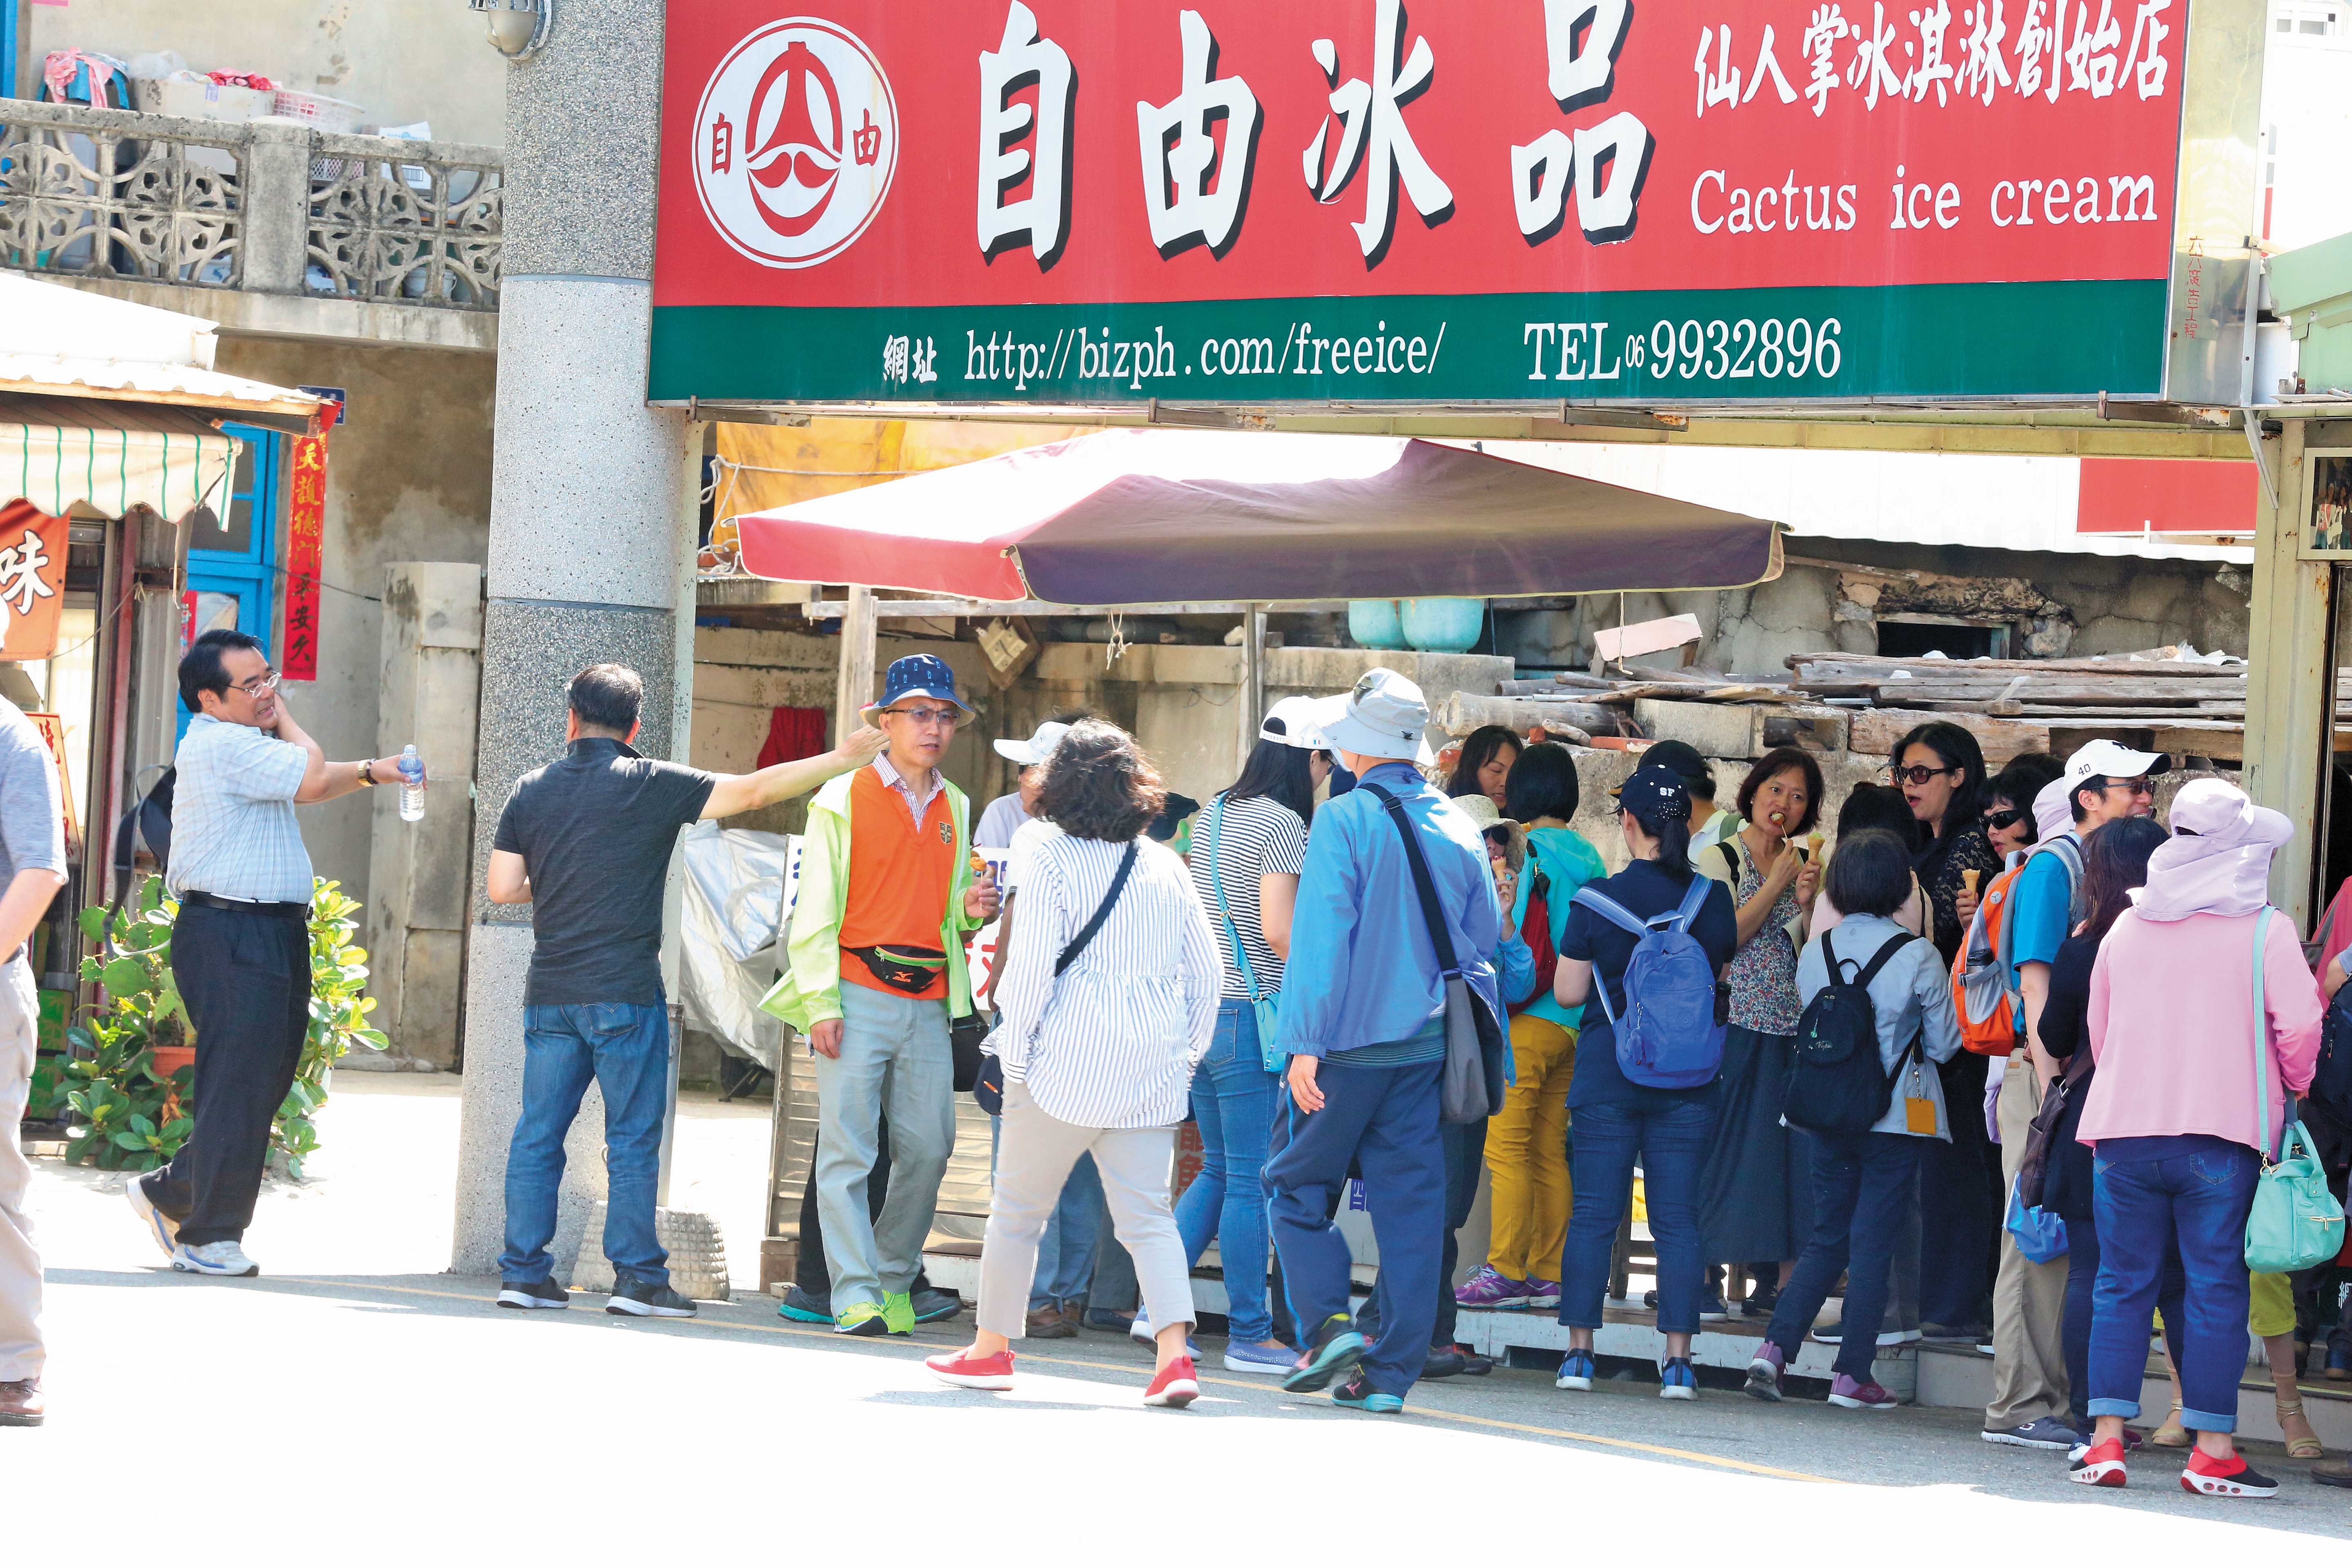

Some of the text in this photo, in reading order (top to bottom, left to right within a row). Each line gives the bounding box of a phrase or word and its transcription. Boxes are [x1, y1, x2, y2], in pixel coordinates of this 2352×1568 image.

[1694, 0, 2170, 118] 仙人掌冰淇淋創始店
[712, 108, 882, 175] 自 由
[977, 0, 1652, 265] 自由冰品
[1690, 164, 2158, 234] Cactus ice cream
[882, 334, 938, 384] 網址
[1523, 317, 1841, 381] TEL 06 9932896
[0, 529, 55, 616] 味
[1659, 786, 1675, 797] SF
[2078, 764, 2091, 776] 40
